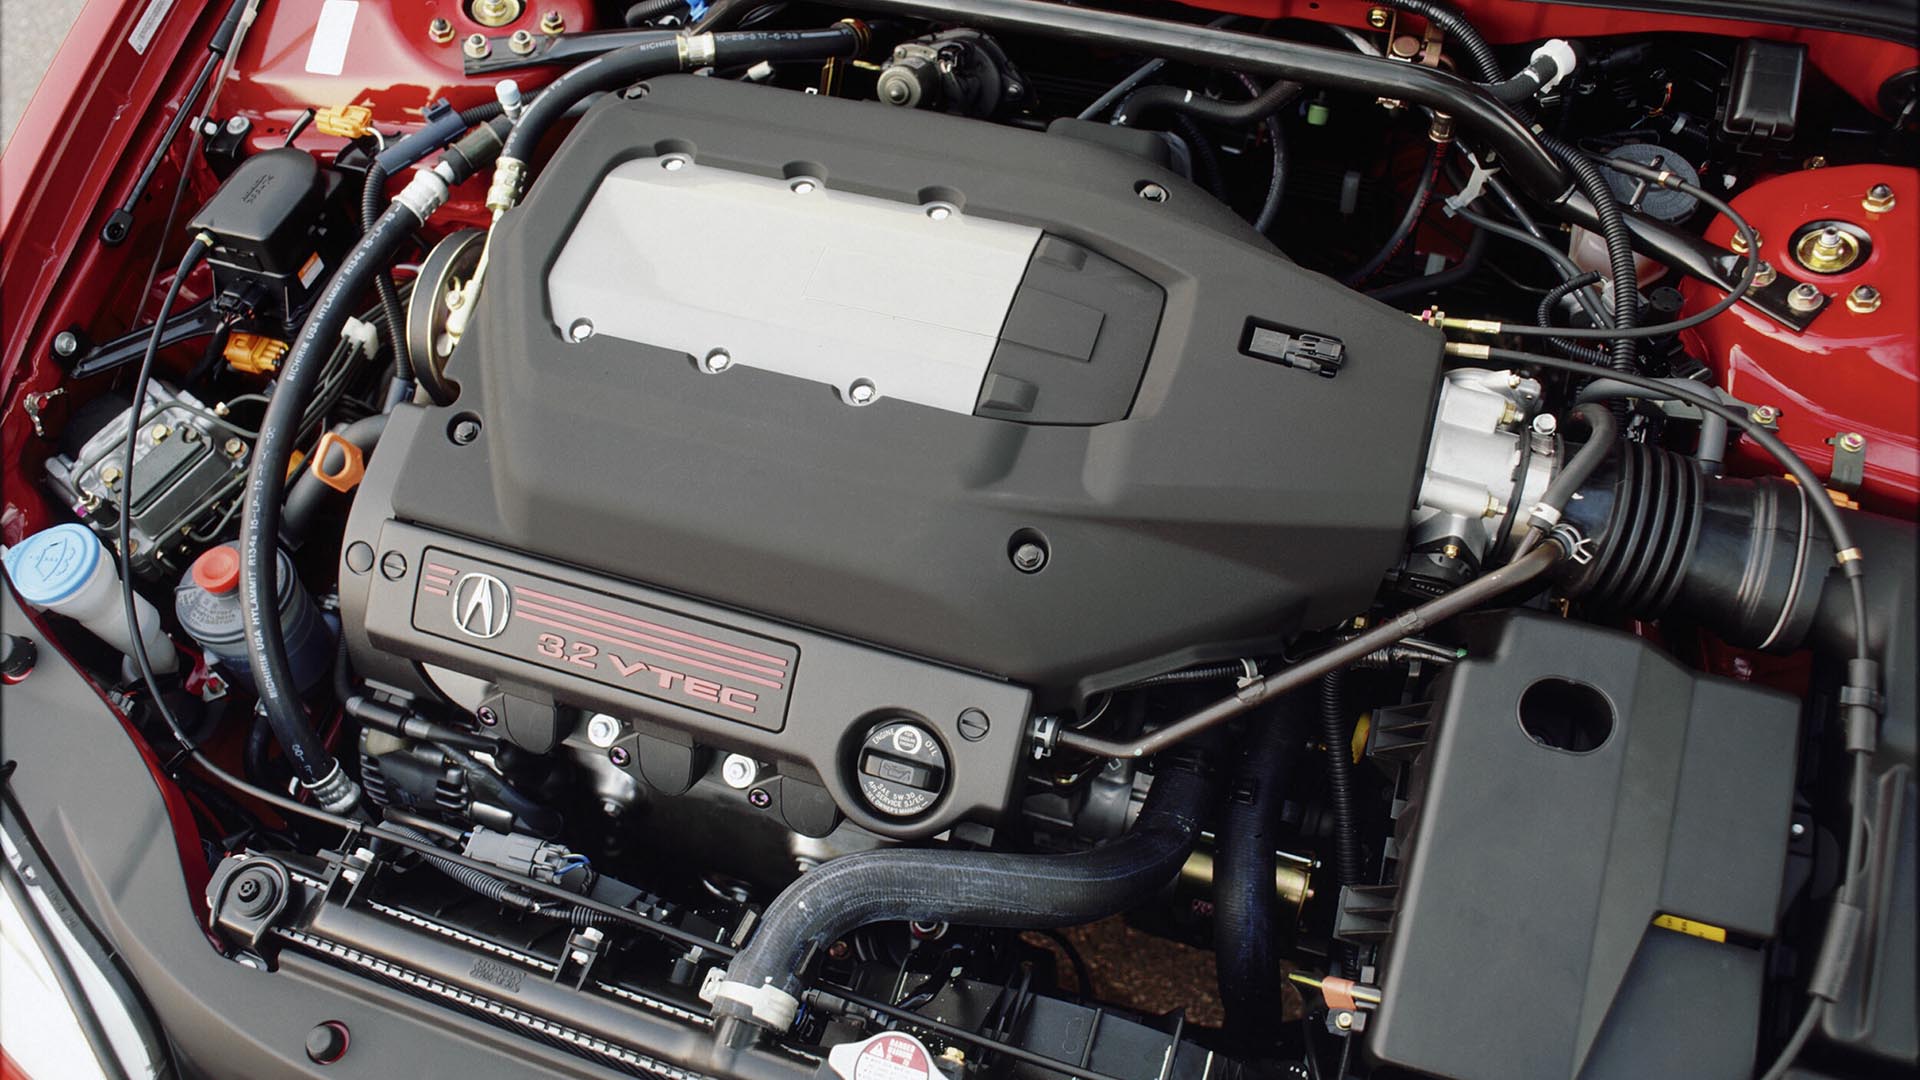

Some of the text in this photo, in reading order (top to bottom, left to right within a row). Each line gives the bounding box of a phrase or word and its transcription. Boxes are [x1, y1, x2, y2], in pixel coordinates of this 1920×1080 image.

[307, 322, 321, 340] USA
[254, 630, 265, 650] USA
[536, 631, 758, 713] 3.2 VTEC
[925, 740, 938, 757] OIL
[878, 783, 890, 796] SAE
[875, 792, 902, 808] SERVICE
